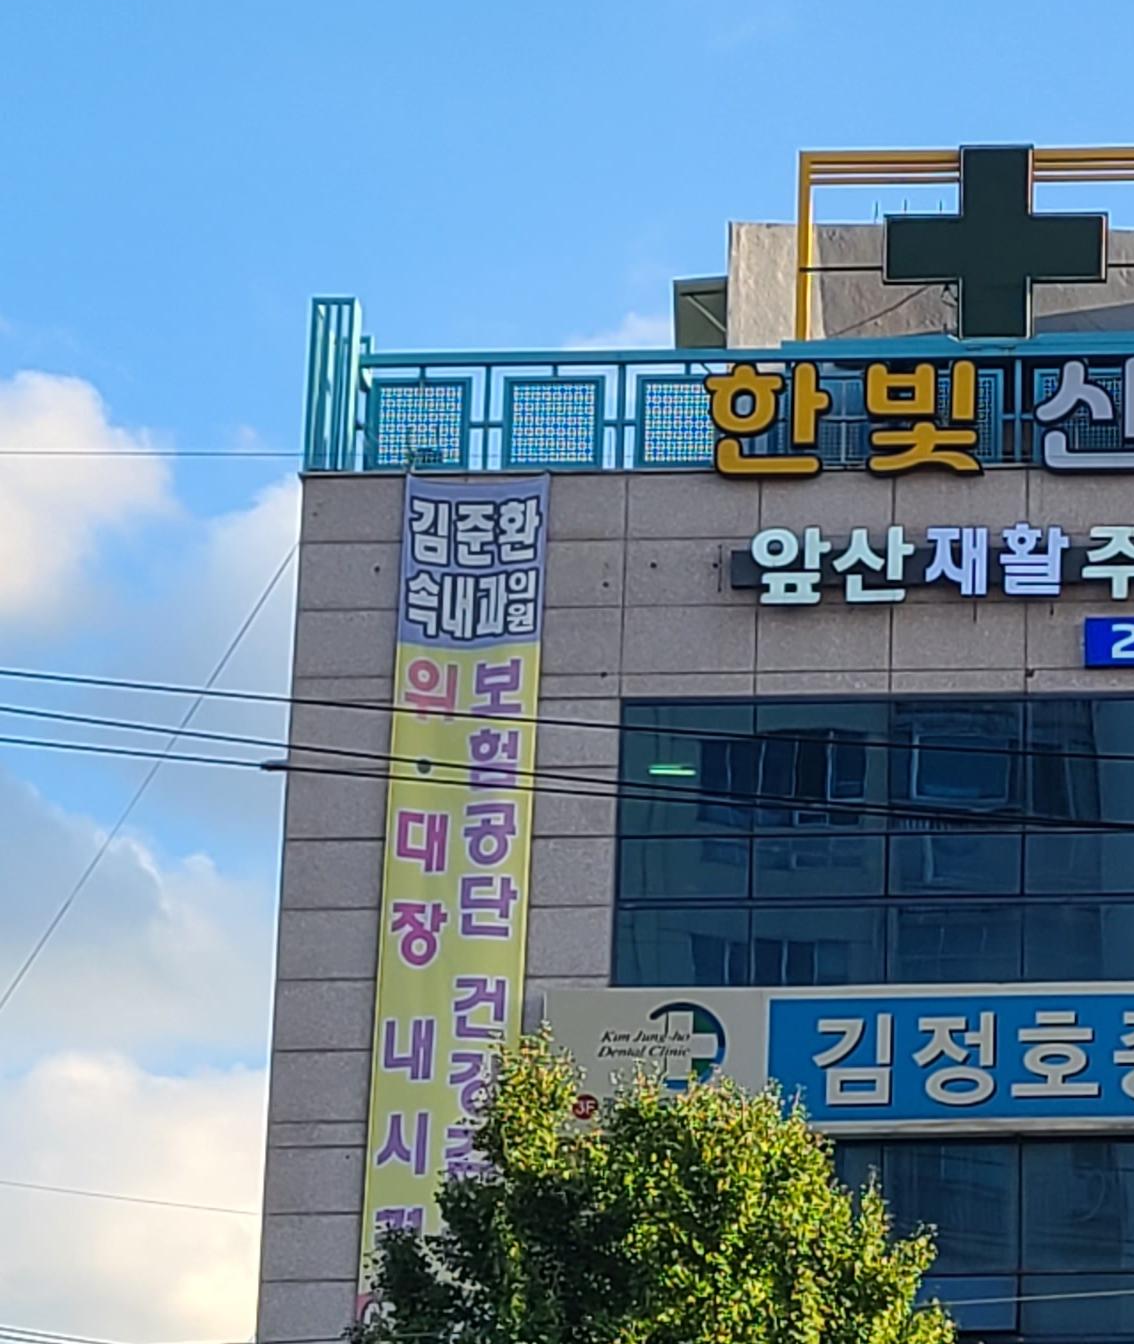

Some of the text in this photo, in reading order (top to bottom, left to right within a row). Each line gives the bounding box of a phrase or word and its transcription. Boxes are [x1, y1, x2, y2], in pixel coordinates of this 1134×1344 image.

[408, 497, 541, 566] 김준환
[600, 1029, 631, 1043] Kim
[598, 1046, 646, 1058] Dental
